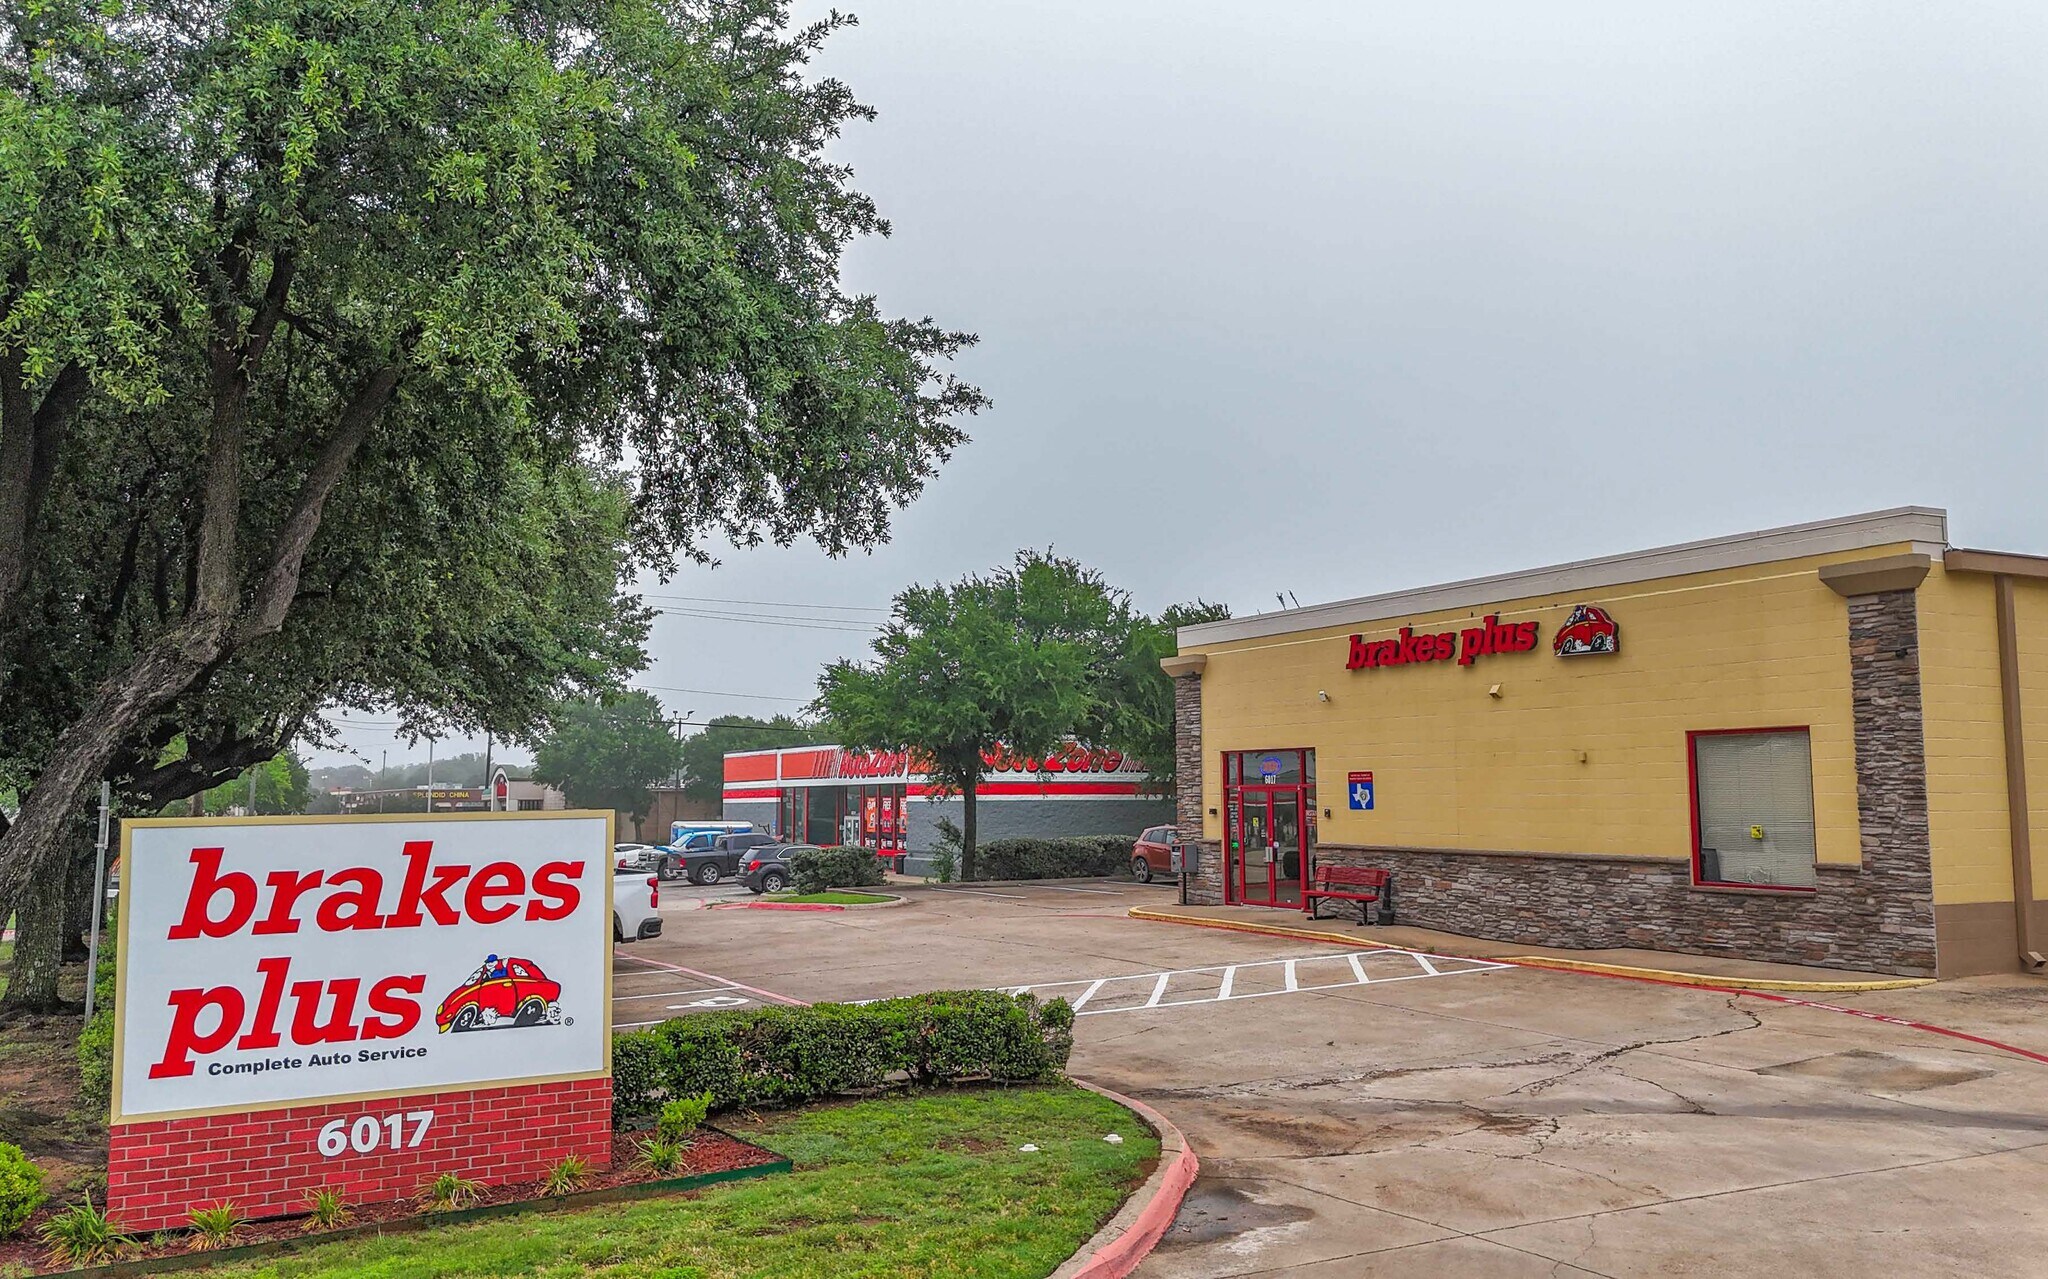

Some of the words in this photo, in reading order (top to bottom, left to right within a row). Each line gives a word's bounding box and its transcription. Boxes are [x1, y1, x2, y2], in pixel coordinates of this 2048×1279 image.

[1346, 627, 1456, 669] brakes
[1458, 615, 1539, 666] plus
[1264, 774, 1276, 784] 6017
[167, 840, 586, 940] brakes
[148, 956, 426, 1080] plus
[207, 1055, 303, 1077] Complete
[308, 1050, 352, 1068] Auto
[357, 1045, 428, 1062] Service
[317, 1110, 435, 1158] 6017
